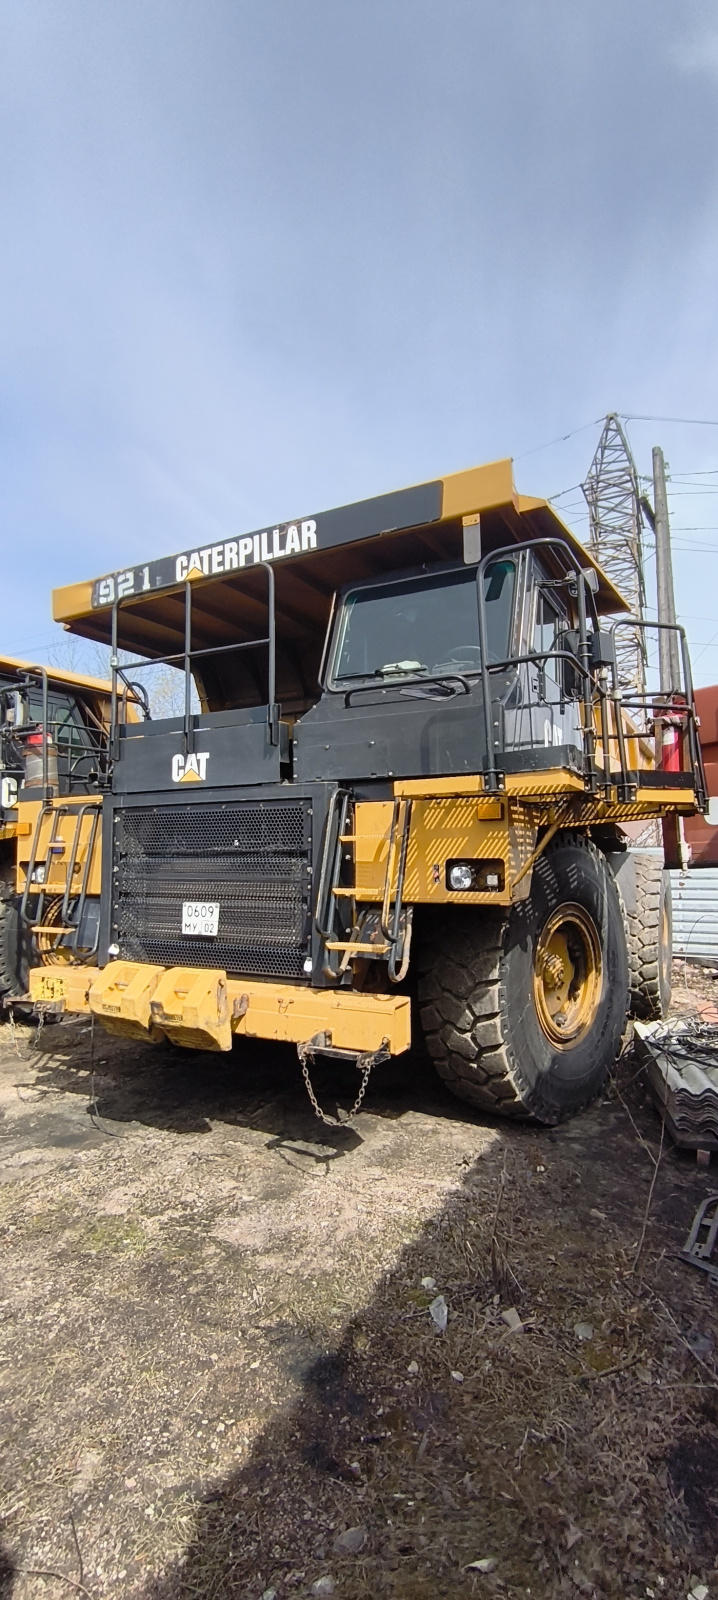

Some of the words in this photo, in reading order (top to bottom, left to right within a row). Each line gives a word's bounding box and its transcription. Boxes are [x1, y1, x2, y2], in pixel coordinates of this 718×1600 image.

[175, 519, 317, 582] CATERPILLAR
[171, 752, 210, 782] CAT
[187, 905, 214, 918] 0609
[204, 923, 214, 934] 02
